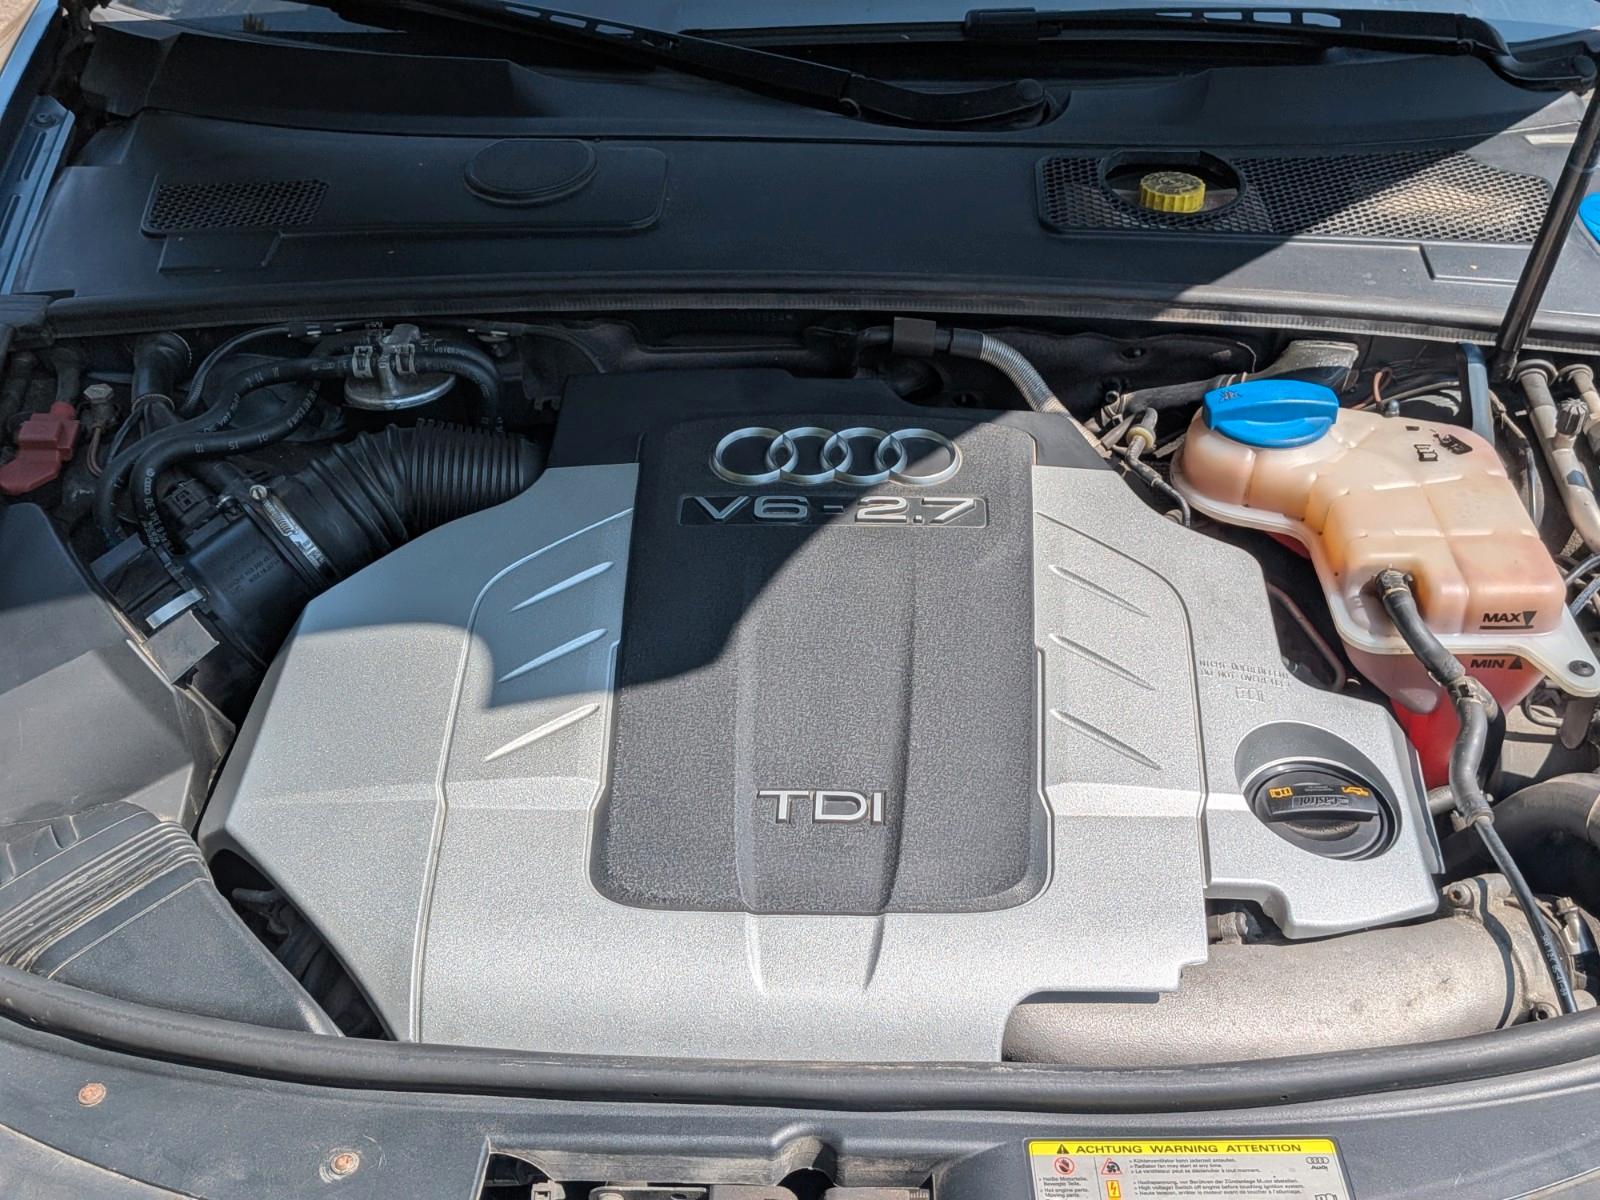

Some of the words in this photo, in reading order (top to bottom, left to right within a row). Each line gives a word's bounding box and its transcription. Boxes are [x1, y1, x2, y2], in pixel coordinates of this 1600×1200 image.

[1483, 612, 1522, 623] MAX
[1471, 659, 1505, 668] MIN
[757, 789, 884, 823] TDI
[1300, 796, 1338, 806] Castrol
[1076, 1145, 1142, 1154] ACHTUNG
[1150, 1144, 1218, 1153] WARNING
[1226, 1143, 1302, 1153] ATTENTION
